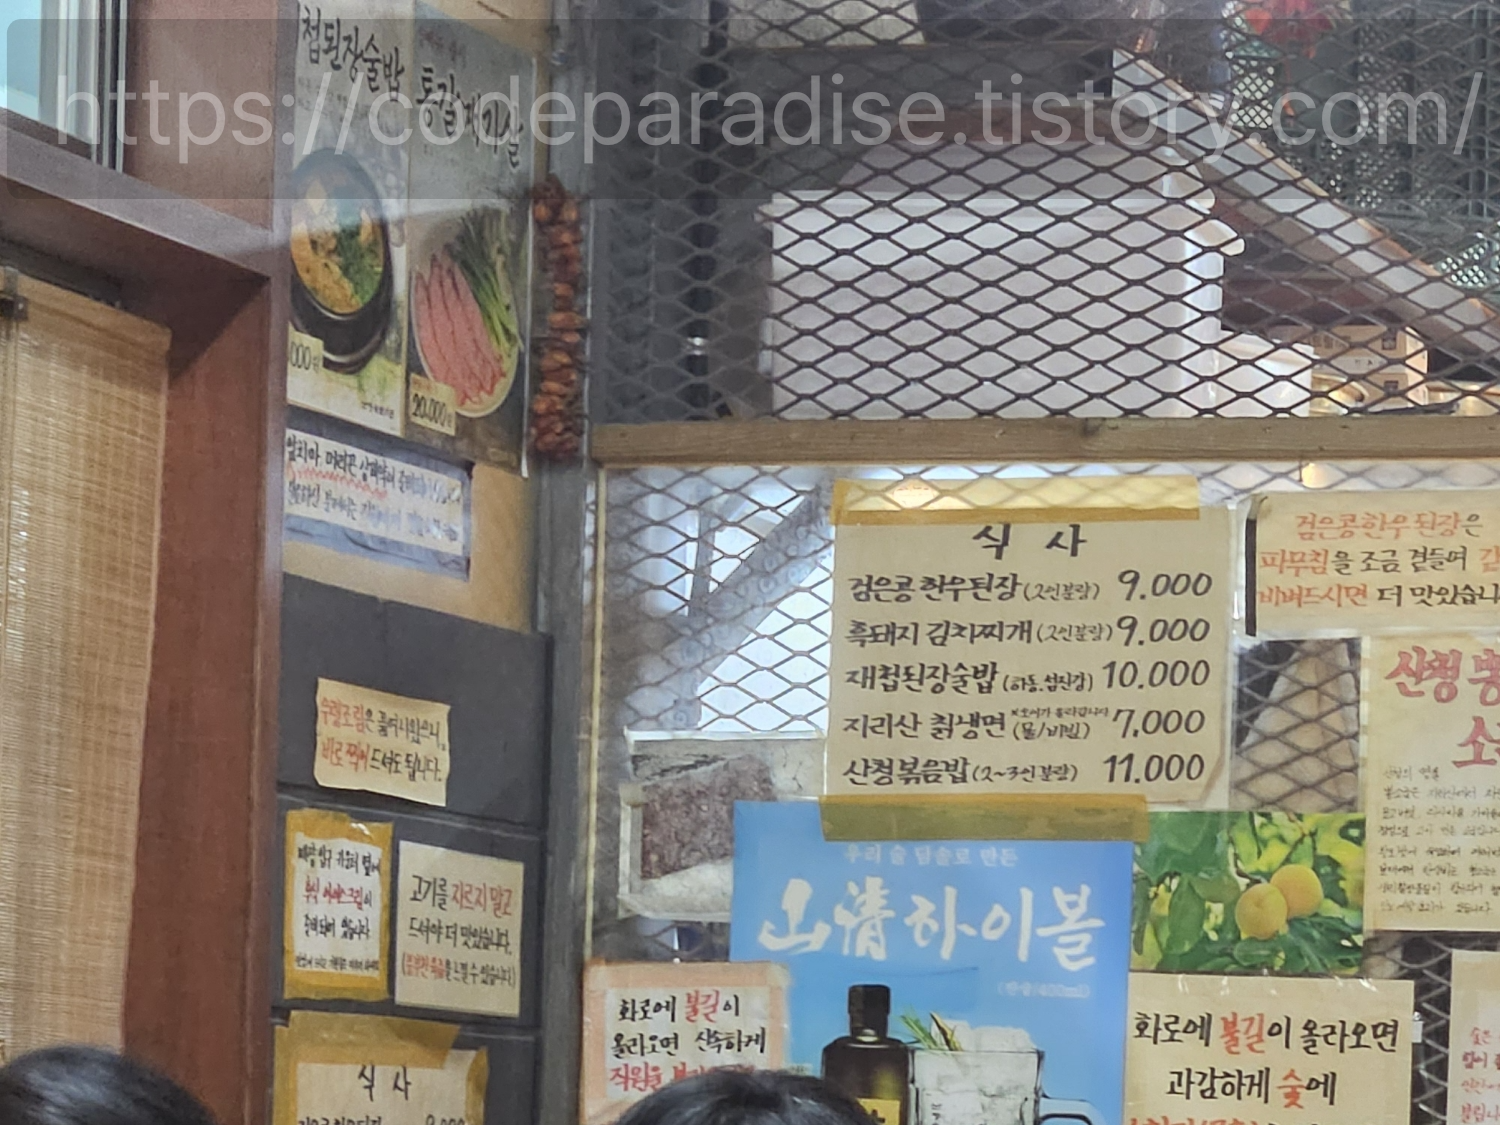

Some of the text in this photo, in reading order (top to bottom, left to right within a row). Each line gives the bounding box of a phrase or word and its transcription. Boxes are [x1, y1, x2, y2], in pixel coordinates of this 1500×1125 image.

[972, 523, 1087, 560] 식 사
[1260, 548, 1354, 577] 파무침을
[1359, 549, 1401, 574] 조금
[1408, 546, 1468, 574] 곁들여
[848, 574, 915, 603] 검은콩
[920, 572, 1022, 602] 한우된장
[1257, 583, 1369, 609] 비벼드시면
[1377, 584, 1403, 608] 더
[844, 620, 920, 648] 흑돼지
[925, 618, 1034, 648] 김치찌개
[844, 660, 999, 695] 재첩된장술밥
[1102, 659, 1211, 690] 10.000
[842, 712, 922, 739] 지리산
[930, 710, 1006, 740] 칡냉면
[1102, 753, 1205, 784] 11.000
[409, 874, 448, 911] 고기를
[618, 989, 740, 1023] 화로에 불길이
[611, 1026, 768, 1060] 올라오면 신속하게
[1132, 1011, 1399, 1056] 화로에 불길이 올라오면
[358, 1064, 413, 1102] 식 사
[1166, 1067, 1337, 1110] 과감하게 숯에
